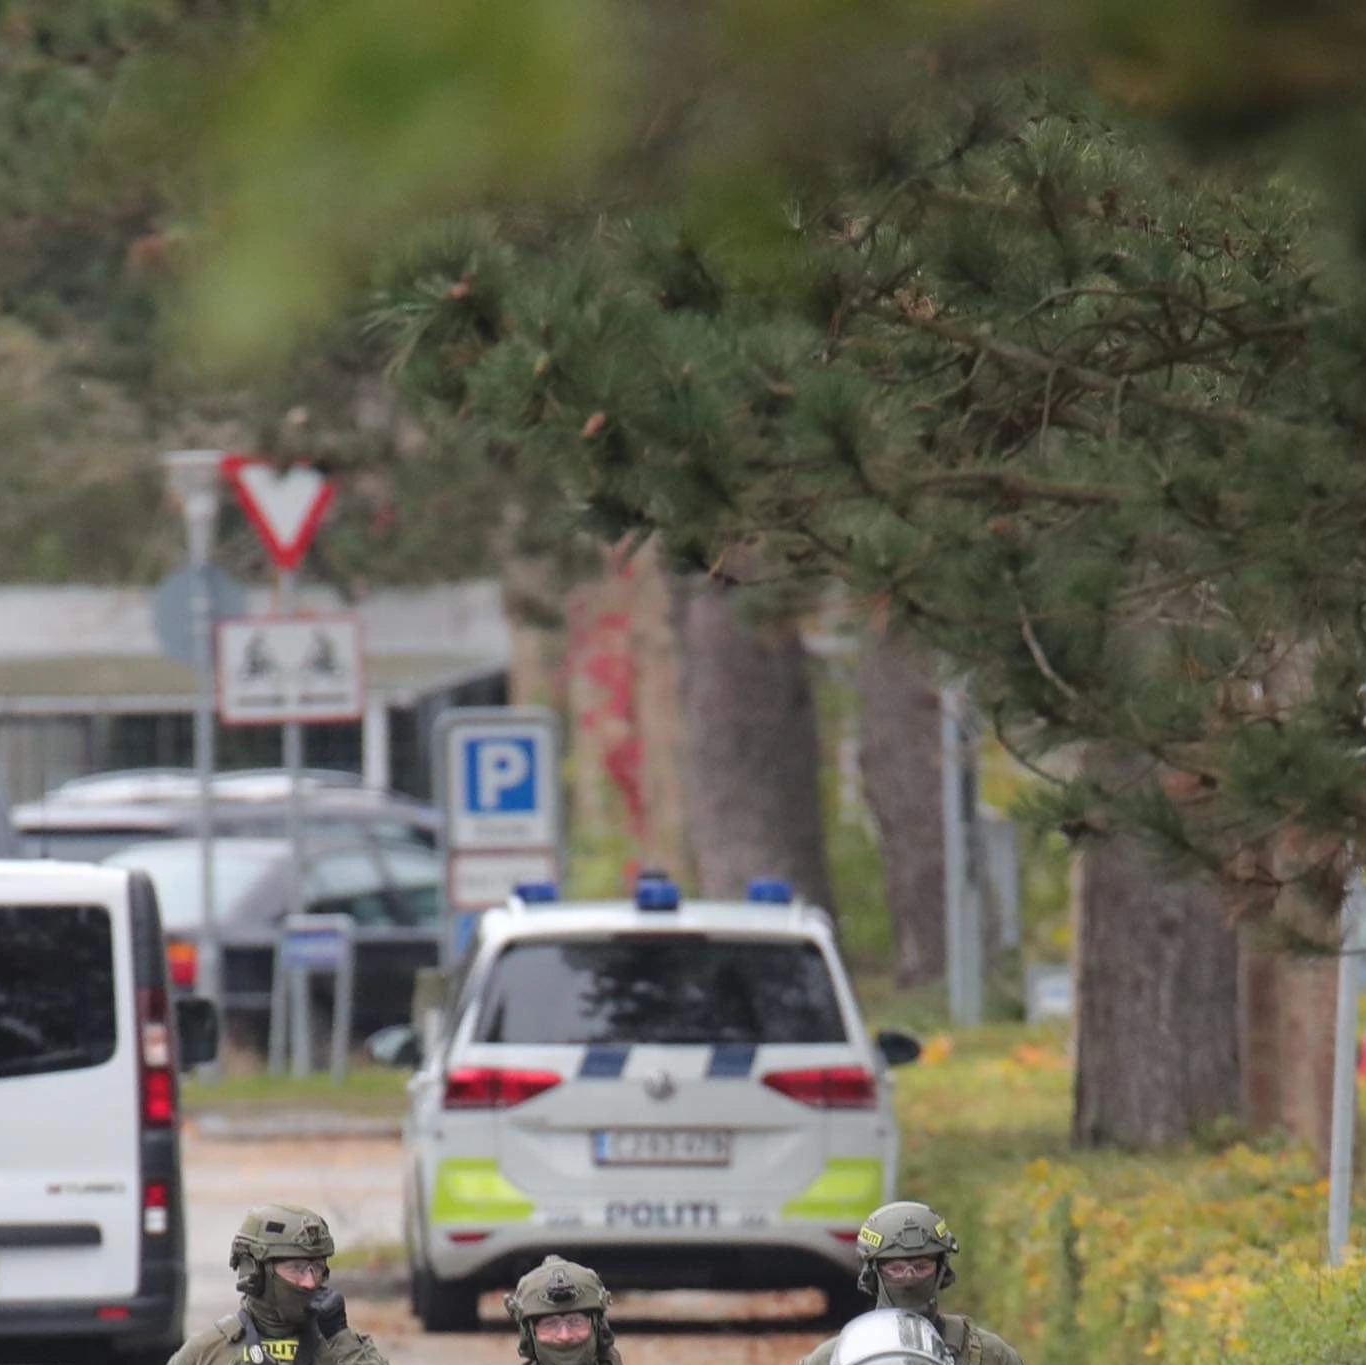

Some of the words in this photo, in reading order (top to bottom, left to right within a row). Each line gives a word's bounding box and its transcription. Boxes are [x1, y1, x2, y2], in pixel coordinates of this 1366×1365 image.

[478, 741, 528, 807] P
[606, 1202, 719, 1228] POLITI
[860, 1228, 881, 1247] OLITI
